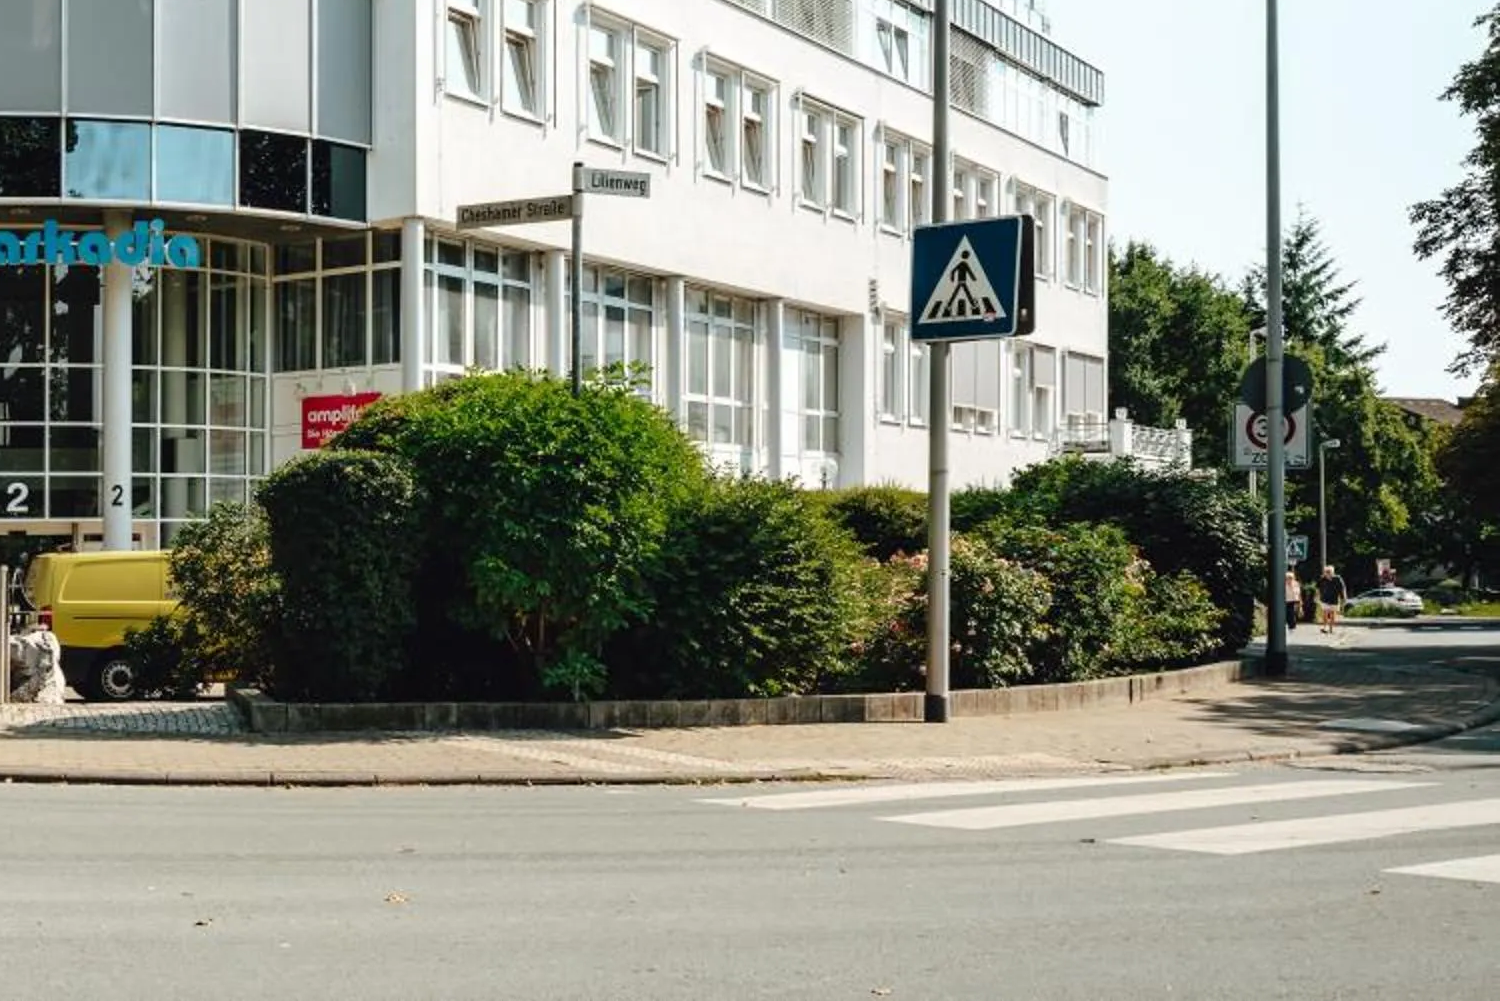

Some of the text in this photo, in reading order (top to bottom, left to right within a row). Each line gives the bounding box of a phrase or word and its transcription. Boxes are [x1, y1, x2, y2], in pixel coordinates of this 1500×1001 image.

[591, 172, 647, 196] Lilienweg
[461, 199, 565, 224] Cheshamer Straße
[6, 482, 30, 512] 2
[111, 484, 124, 507] 2
